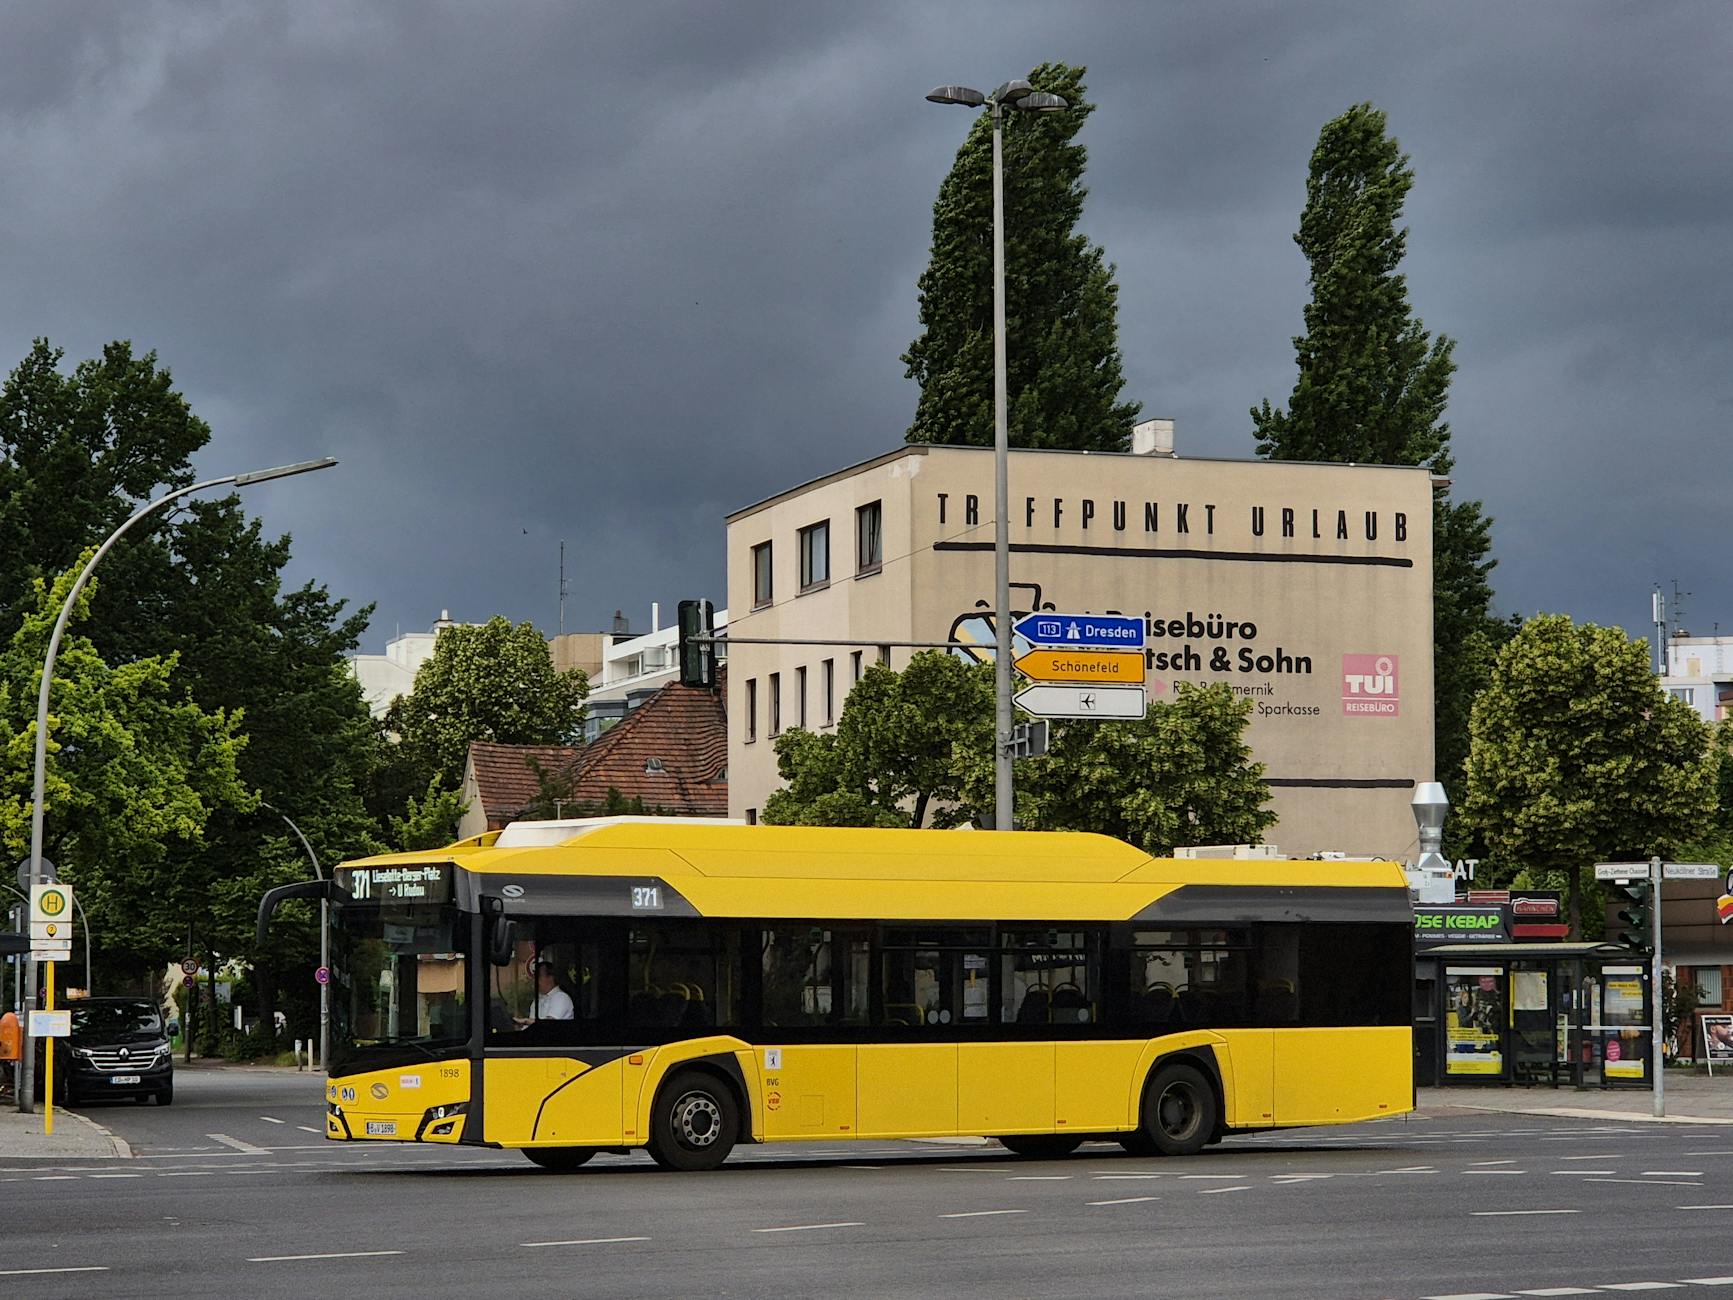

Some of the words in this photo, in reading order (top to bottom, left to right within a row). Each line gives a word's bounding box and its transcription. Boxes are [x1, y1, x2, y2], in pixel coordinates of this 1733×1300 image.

[937, 493, 1216, 535] TRFFPUNKT
[1252, 506, 1407, 542] URLAUB
[1042, 624, 1057, 634] 113
[1085, 624, 1137, 639] Dresden
[1106, 610, 1257, 640] isebüro
[1052, 659, 1119, 673] Schönefeld
[1209, 646, 1232, 672] &
[1238, 647, 1312, 674] Sohn
[1345, 657, 1393, 694] TUI
[1257, 701, 1321, 717] Sparkasse
[1346, 701, 1395, 713] REISEBÜRO
[352, 870, 370, 899] 371
[633, 887, 657, 907] 371
[1446, 915, 1499, 929] KEBAP
[185, 962, 196, 971] 30
[440, 1068, 460, 1078] 1898
